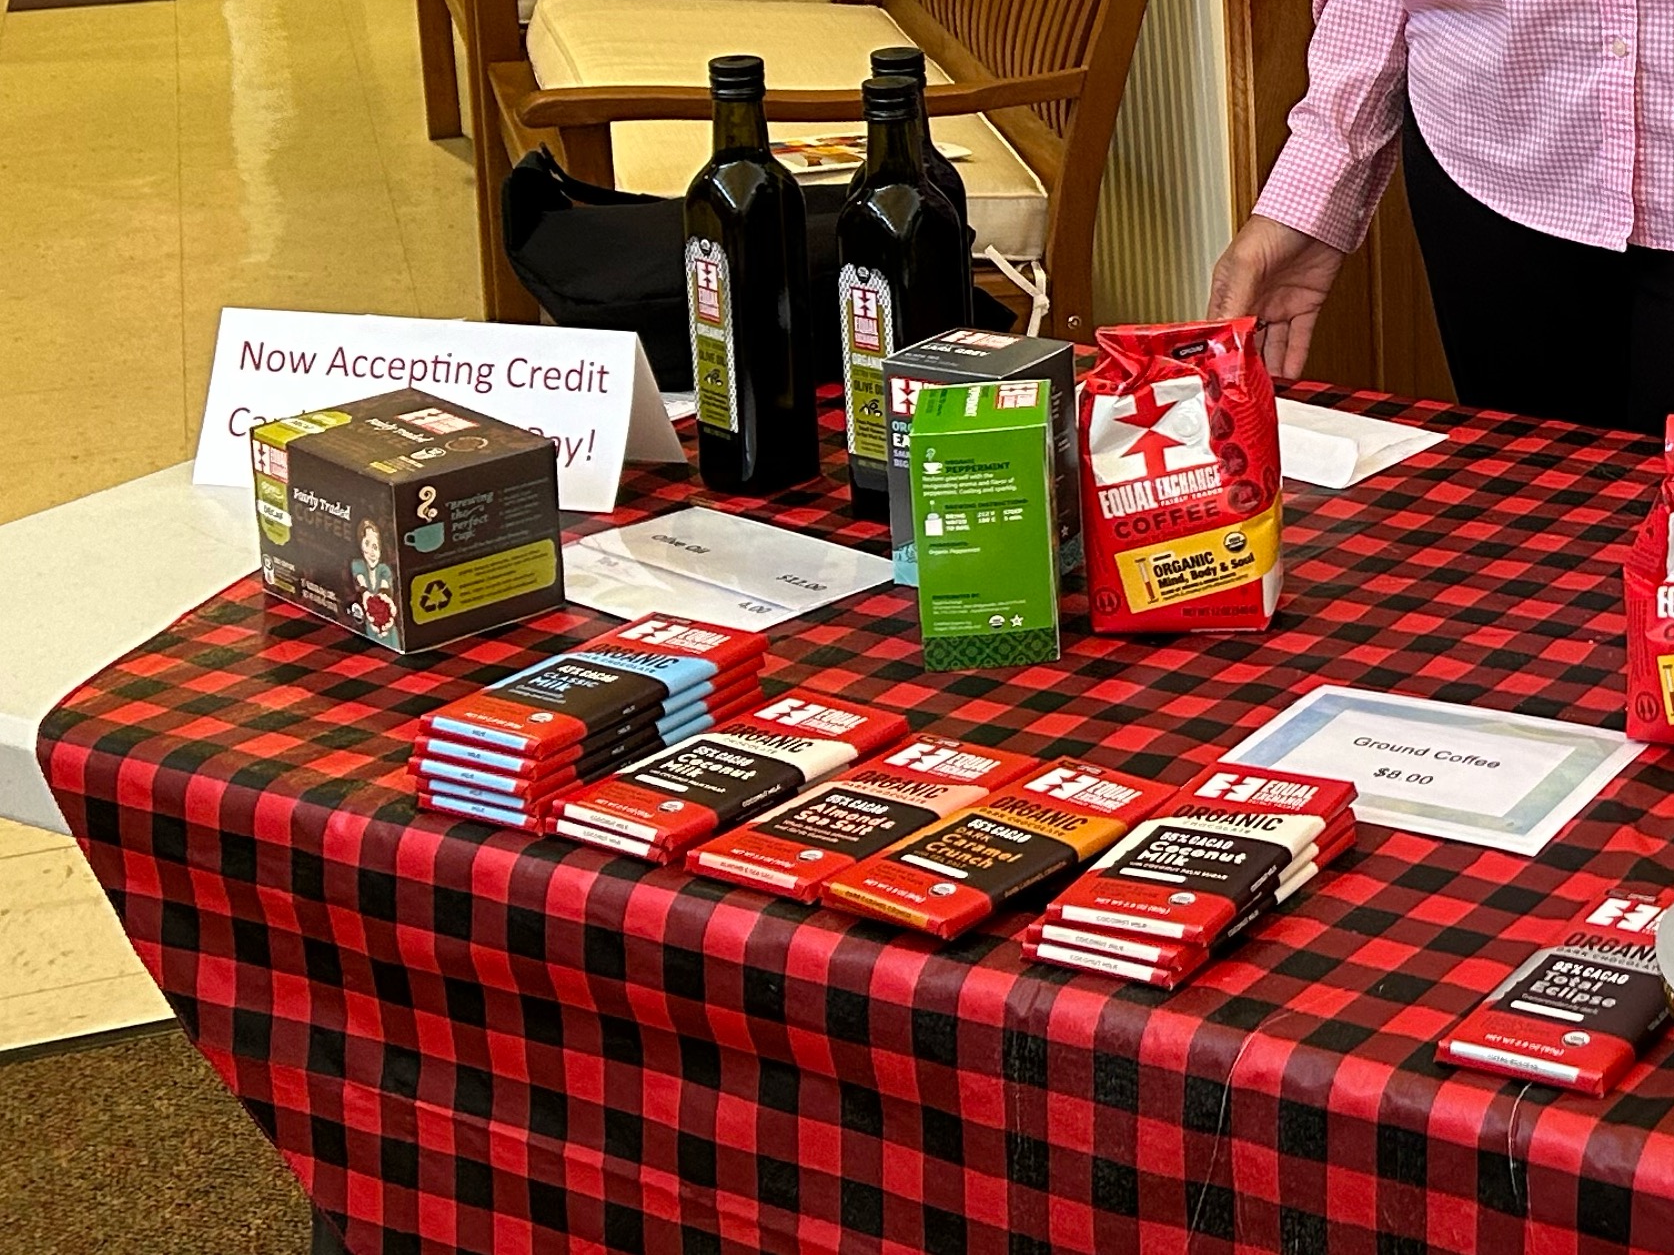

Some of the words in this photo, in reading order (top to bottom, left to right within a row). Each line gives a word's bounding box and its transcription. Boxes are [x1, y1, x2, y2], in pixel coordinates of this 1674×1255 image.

[239, 340, 317, 375] Now
[325, 345, 496, 394] Accepting
[505, 357, 611, 395] Credit
[853, 380, 871, 395] OLIVE
[892, 433, 910, 447] EA
[945, 462, 1010, 473] PEPPERMINT
[293, 487, 319, 512] Fairly
[319, 498, 351, 521] Traded
[1098, 480, 1159, 520] EQUAL
[1155, 465, 1222, 500] EXCHANGE
[1114, 498, 1220, 539] COFFEE
[1153, 551, 1214, 578] ORGANIC
[1157, 573, 1189, 589] Mind,
[1190, 566, 1217, 581] Body
[1219, 561, 1229, 572] &
[1230, 552, 1256, 570] Soul
[588, 642, 679, 669] ORGANIC
[528, 676, 572, 692] Milk
[543, 672, 599, 688] CLASSIC
[723, 724, 814, 753] ORGANIC
[1353, 736, 1430, 758] Ground
[1433, 749, 1501, 770] Coffee
[660, 760, 704, 779] Milk
[677, 753, 757, 781] Coconut
[1373, 766, 1434, 786] $8.00
[852, 769, 949, 800] ORGANIC
[1266, 780, 1320, 797] EQUAL
[794, 810, 830, 827] Sea
[829, 817, 874, 836] Salt
[808, 802, 896, 830] Almonds
[988, 796, 1088, 832] ORGANIC
[1172, 804, 1284, 832] ORGANIC
[942, 833, 1023, 863] Caramel
[955, 826, 991, 843] DARK
[1160, 831, 1190, 843] 55%
[1188, 836, 1235, 850] CACAO
[925, 841, 994, 869] Crunch
[1136, 849, 1190, 867] Milk
[1149, 841, 1247, 865] Coconut
[1545, 970, 1604, 993] Total
[1582, 966, 1630, 985] CACAO
[1530, 979, 1617, 1009] Eclipse
